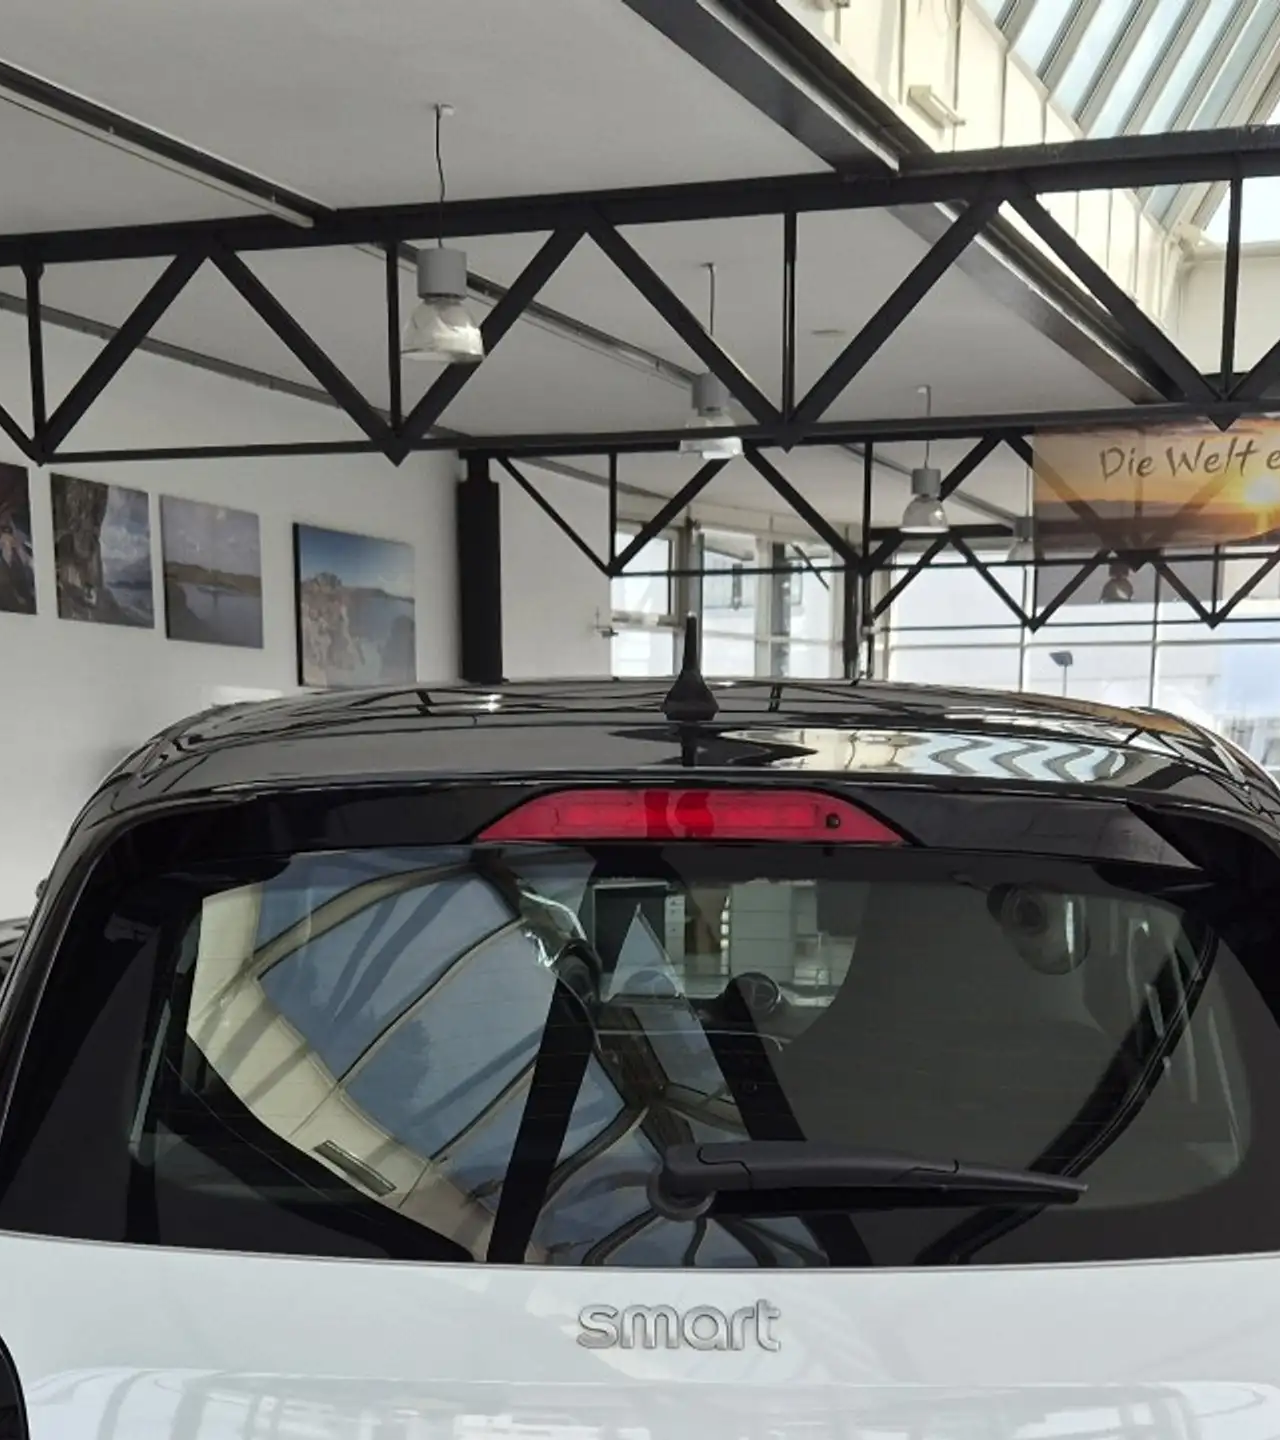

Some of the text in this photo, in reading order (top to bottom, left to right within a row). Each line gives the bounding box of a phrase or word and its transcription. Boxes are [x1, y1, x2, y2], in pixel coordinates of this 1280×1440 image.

[1099, 447, 1155, 481] Die
[1166, 437, 1260, 477] Welt
[576, 1298, 781, 1352] smart
